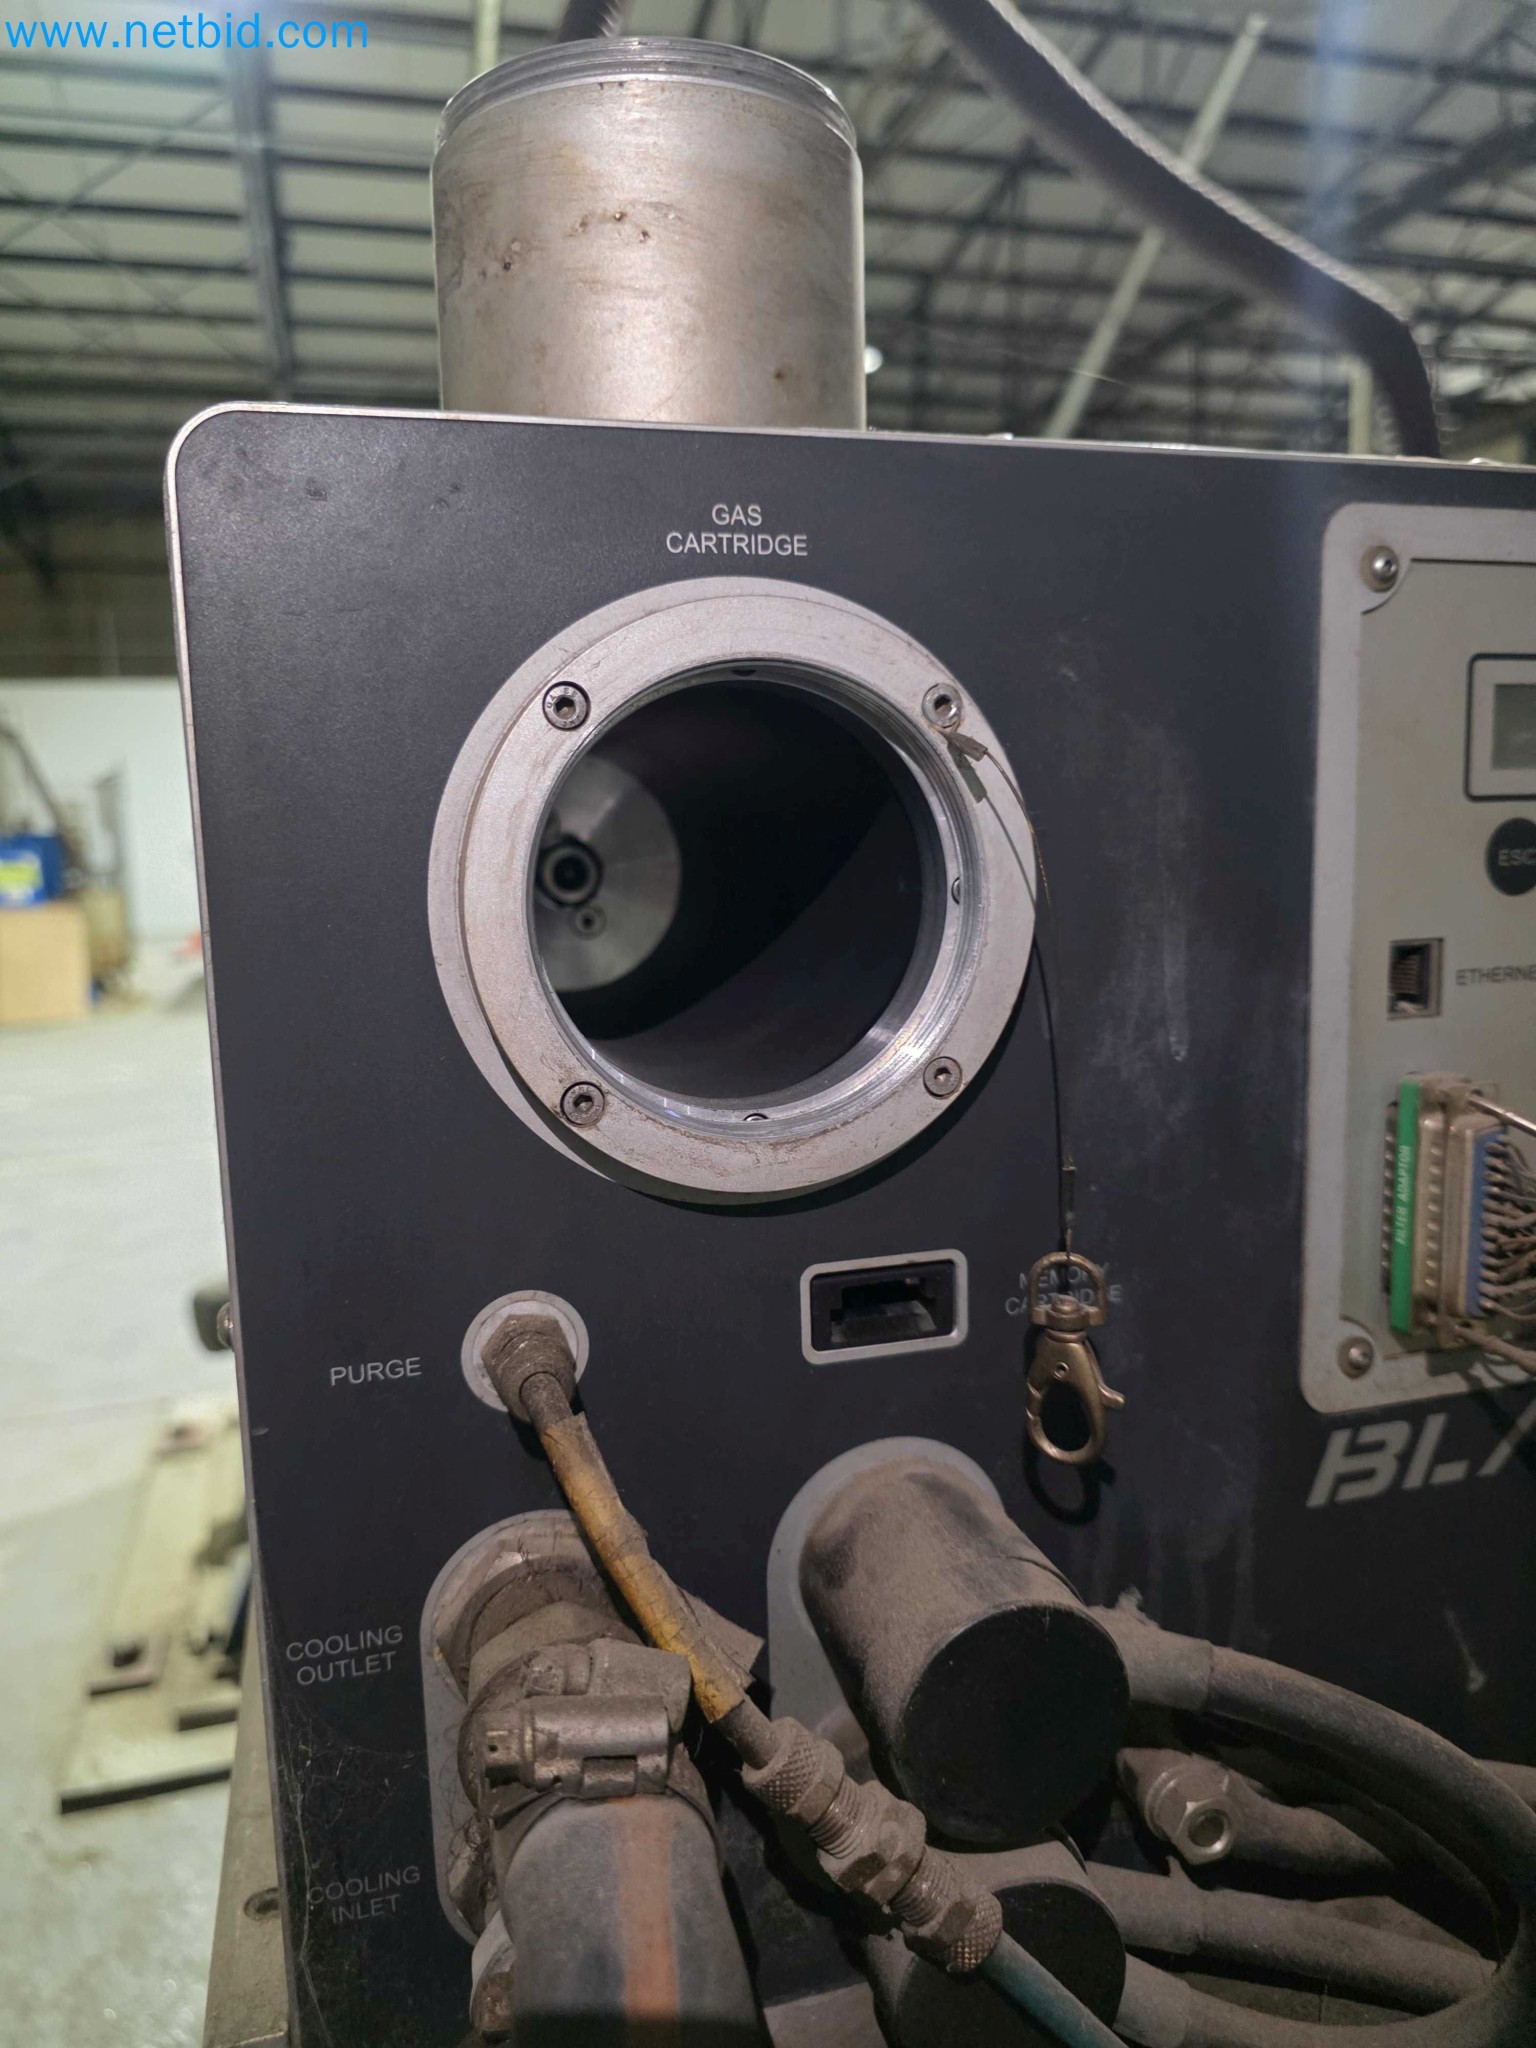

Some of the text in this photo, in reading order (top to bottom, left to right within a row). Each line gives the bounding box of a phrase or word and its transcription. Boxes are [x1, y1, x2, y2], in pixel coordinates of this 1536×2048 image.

[711, 503, 763, 526] GAS
[666, 531, 809, 556] CARTRIDGE
[1498, 848, 1536, 867] ESC
[330, 1357, 422, 1387] PURGE
[286, 1624, 404, 1661] COOLING
[296, 1651, 397, 1686] OUTLET
[309, 1864, 421, 1904] COOLING
[332, 1893, 400, 1925] INLET
